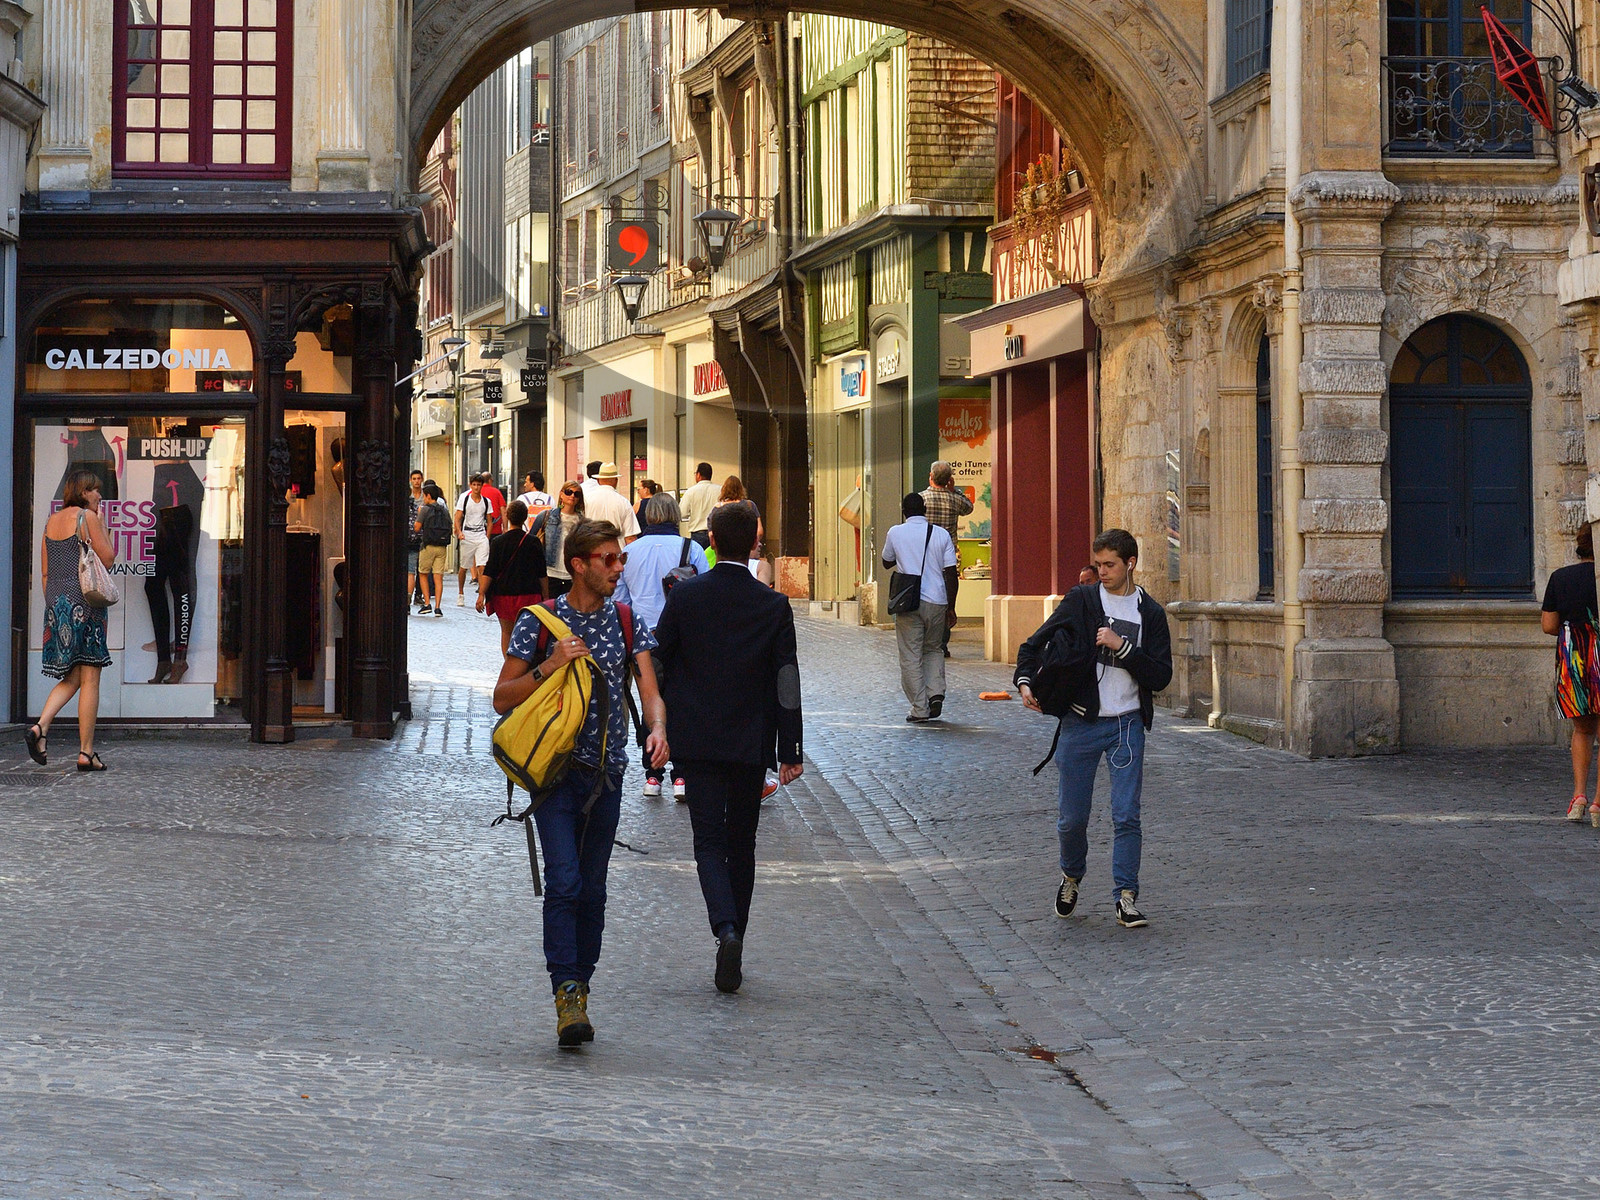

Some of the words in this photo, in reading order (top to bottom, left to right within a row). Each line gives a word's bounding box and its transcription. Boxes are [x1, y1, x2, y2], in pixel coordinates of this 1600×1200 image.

[45, 348, 232, 371] CALZEDONIA
[945, 408, 983, 431] endless
[141, 439, 206, 458] PUSH-UP
[181, 593, 189, 646] WORKOUT
